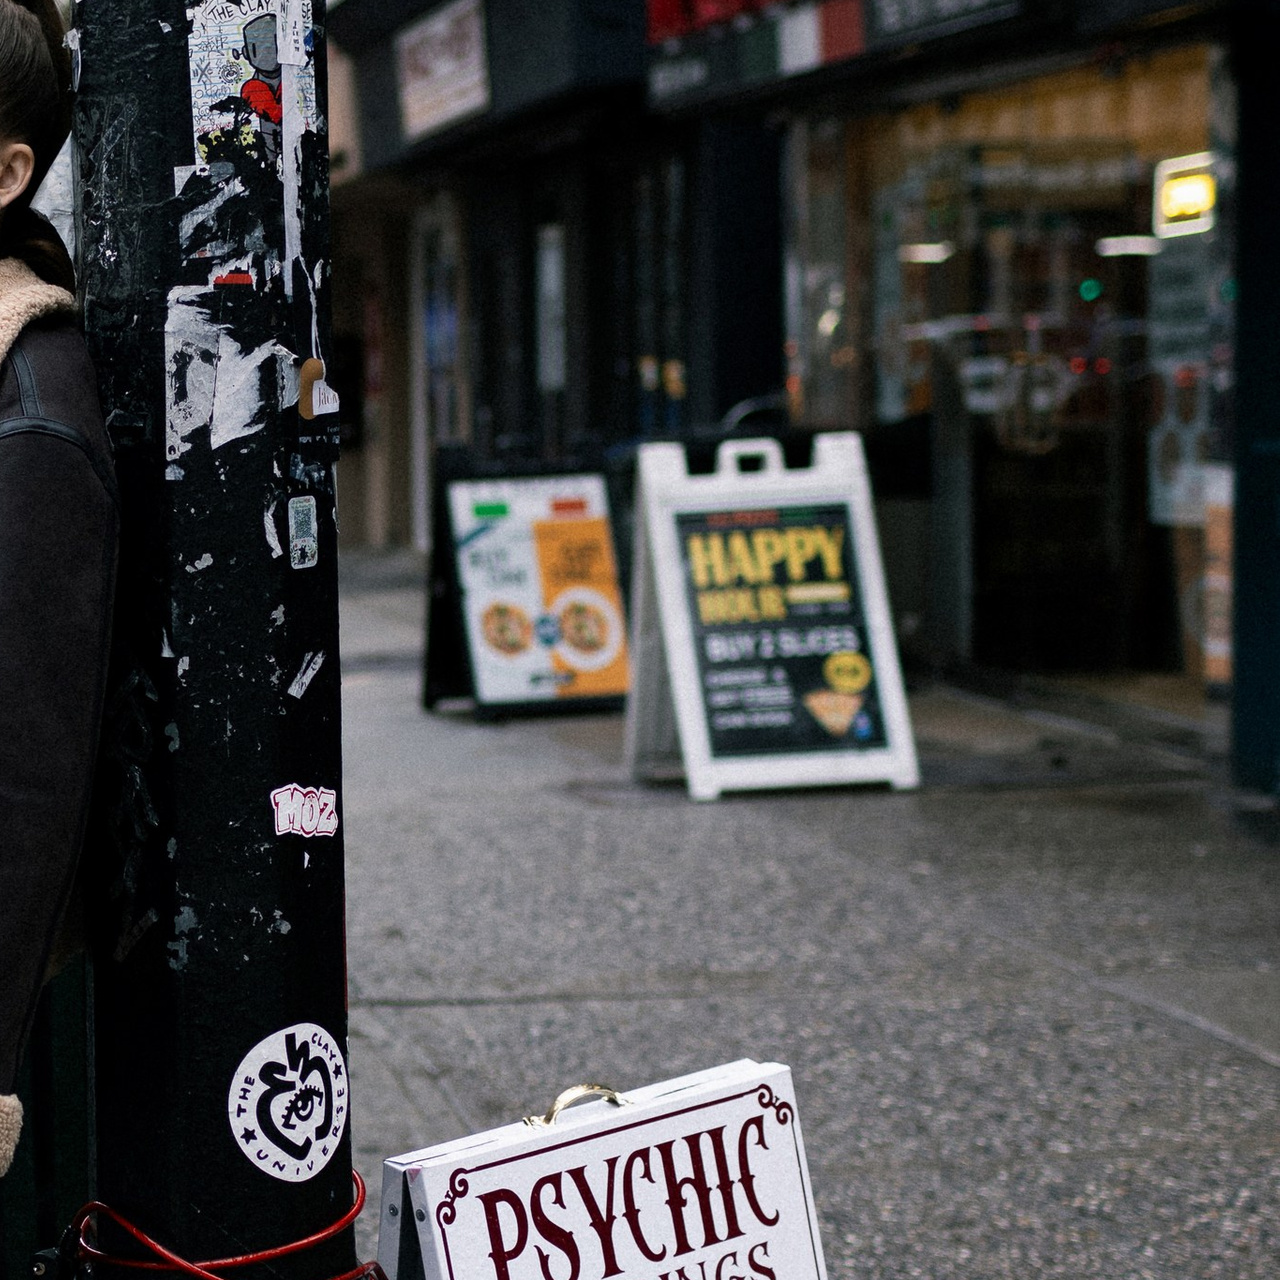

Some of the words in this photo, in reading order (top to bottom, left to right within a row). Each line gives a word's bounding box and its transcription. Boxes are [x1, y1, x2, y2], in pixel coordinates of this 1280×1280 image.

[208, 5, 234, 21] THE
[686, 526, 844, 588] HAPPY
[698, 586, 786, 625] HOUR
[271, 785, 338, 837] MOZ
[236, 1075, 255, 1118] THE
[311, 1032, 337, 1062] CLAY
[256, 1087, 345, 1175] UNIVERSE
